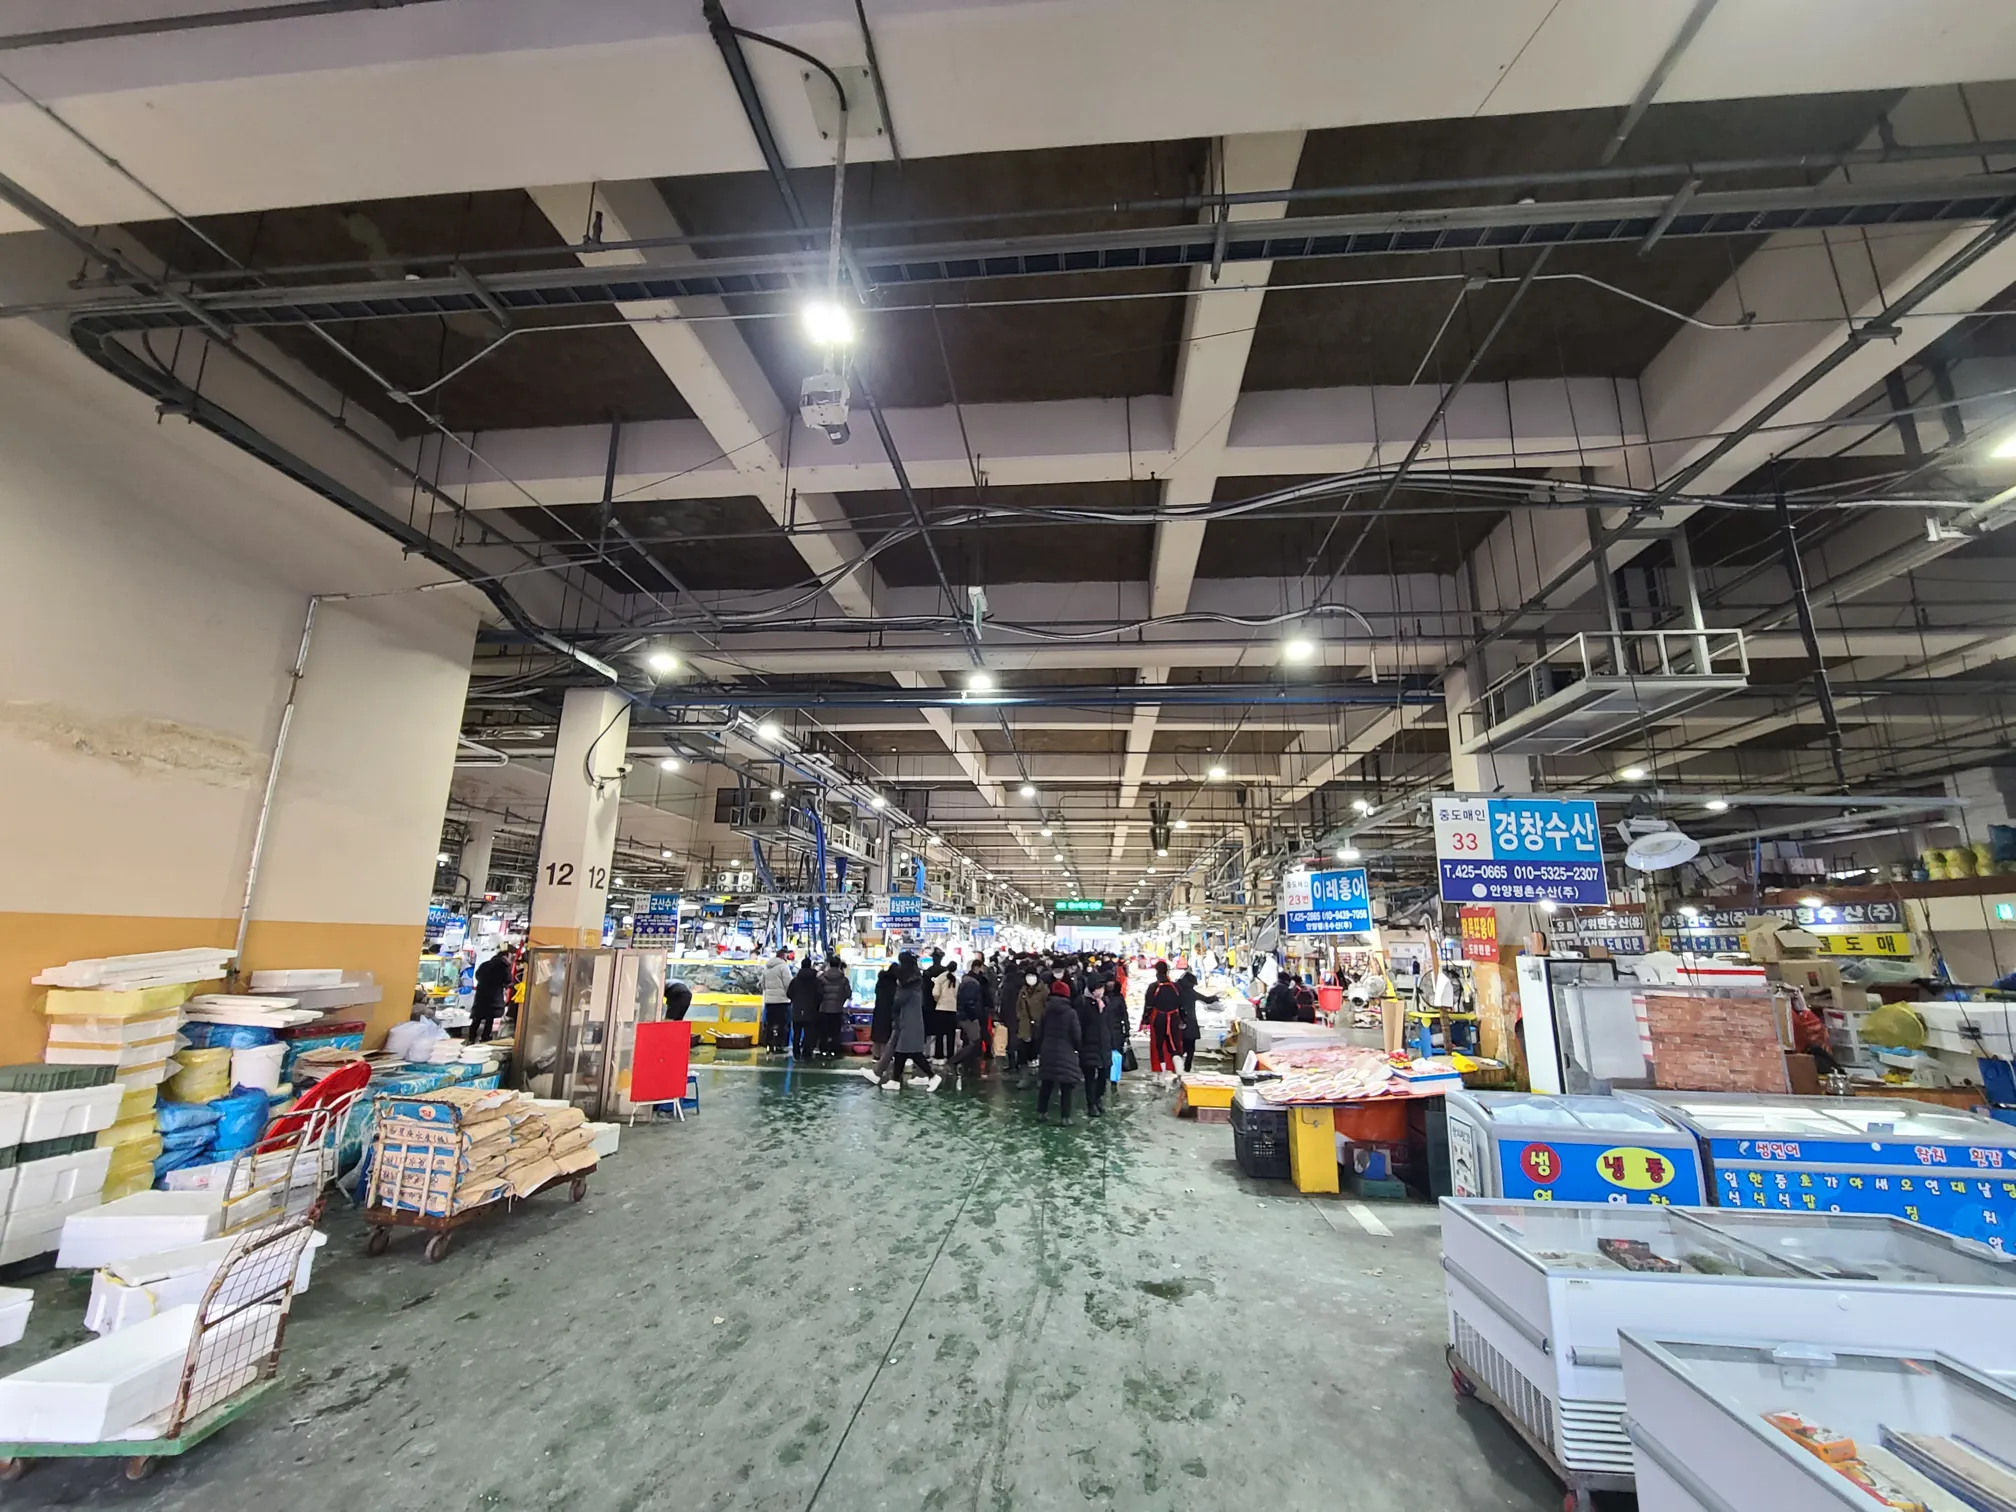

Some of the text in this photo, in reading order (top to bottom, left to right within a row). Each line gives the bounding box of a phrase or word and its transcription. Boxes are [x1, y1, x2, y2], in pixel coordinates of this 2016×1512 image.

[1439, 809, 1486, 822] 중도매인
[1452, 832, 1478, 851] 33
[1494, 811, 1596, 851] 경창수산
[545, 862, 574, 886] 12
[588, 866, 606, 890] 12
[1443, 864, 1599, 881] T.425-0665 010-5325-2307
[1313, 875, 1366, 902] 이레홍어
[1489, 884, 1579, 899] 안양평촌수산(주)
[1530, 1151, 1551, 1177] 생
[1914, 1145, 1947, 1165] 참치
[1602, 1155, 1666, 1184] 냉동
